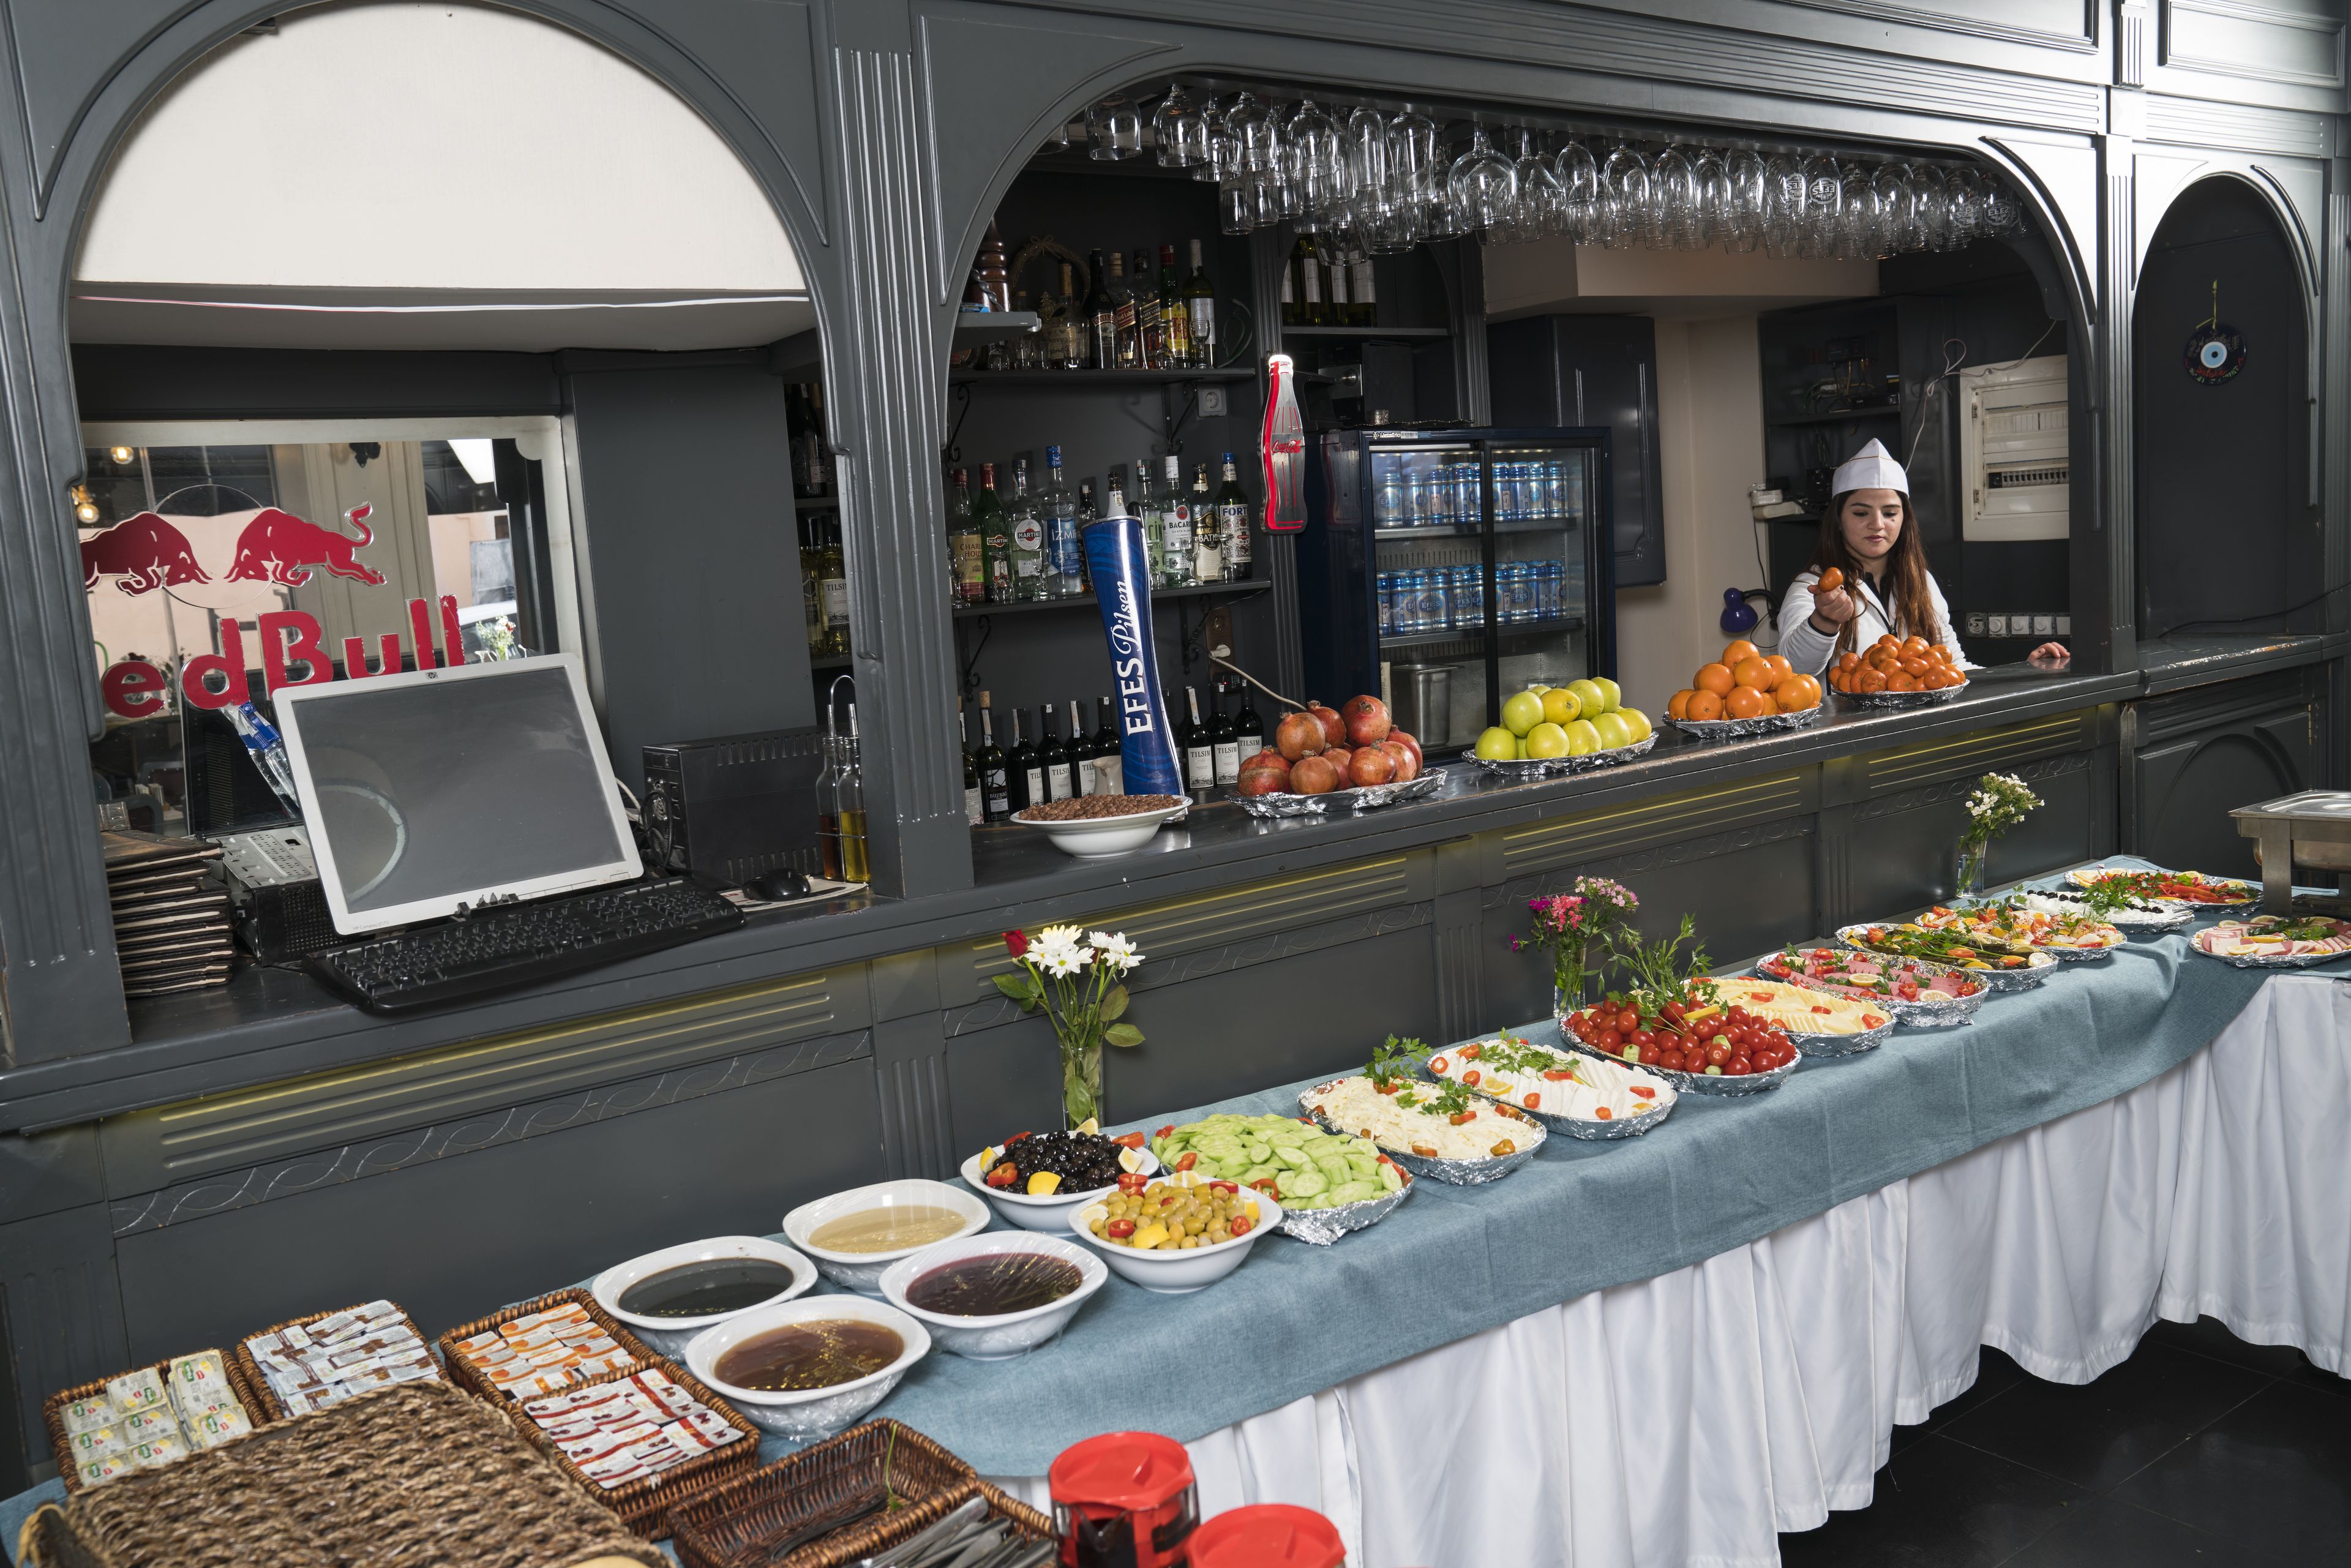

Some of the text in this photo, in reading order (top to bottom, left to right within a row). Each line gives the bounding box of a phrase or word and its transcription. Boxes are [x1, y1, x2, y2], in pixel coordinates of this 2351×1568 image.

[100, 595, 466, 719] ed Bull
[1110, 579, 1142, 656] Pilsen
[1116, 657, 1153, 737] EFES
